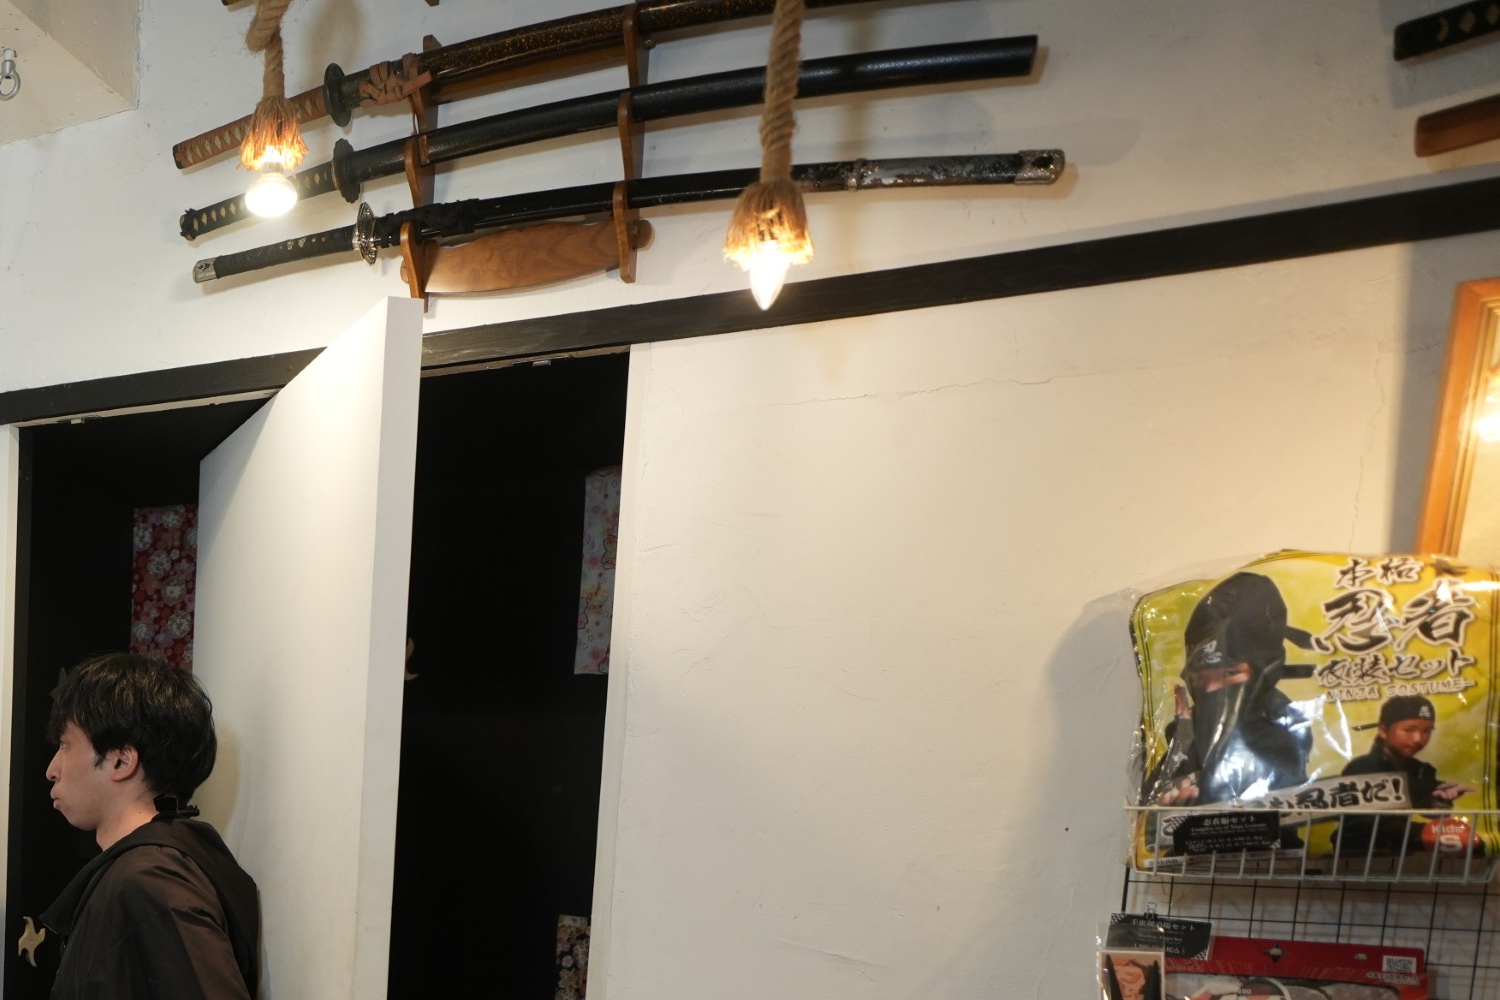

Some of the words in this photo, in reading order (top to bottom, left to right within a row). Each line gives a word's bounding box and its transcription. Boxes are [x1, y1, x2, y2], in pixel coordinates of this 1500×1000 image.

[1312, 578, 1476, 655] 忍者
[1326, 685, 1380, 703] NINJA
[1386, 679, 1468, 698] COSTUME
